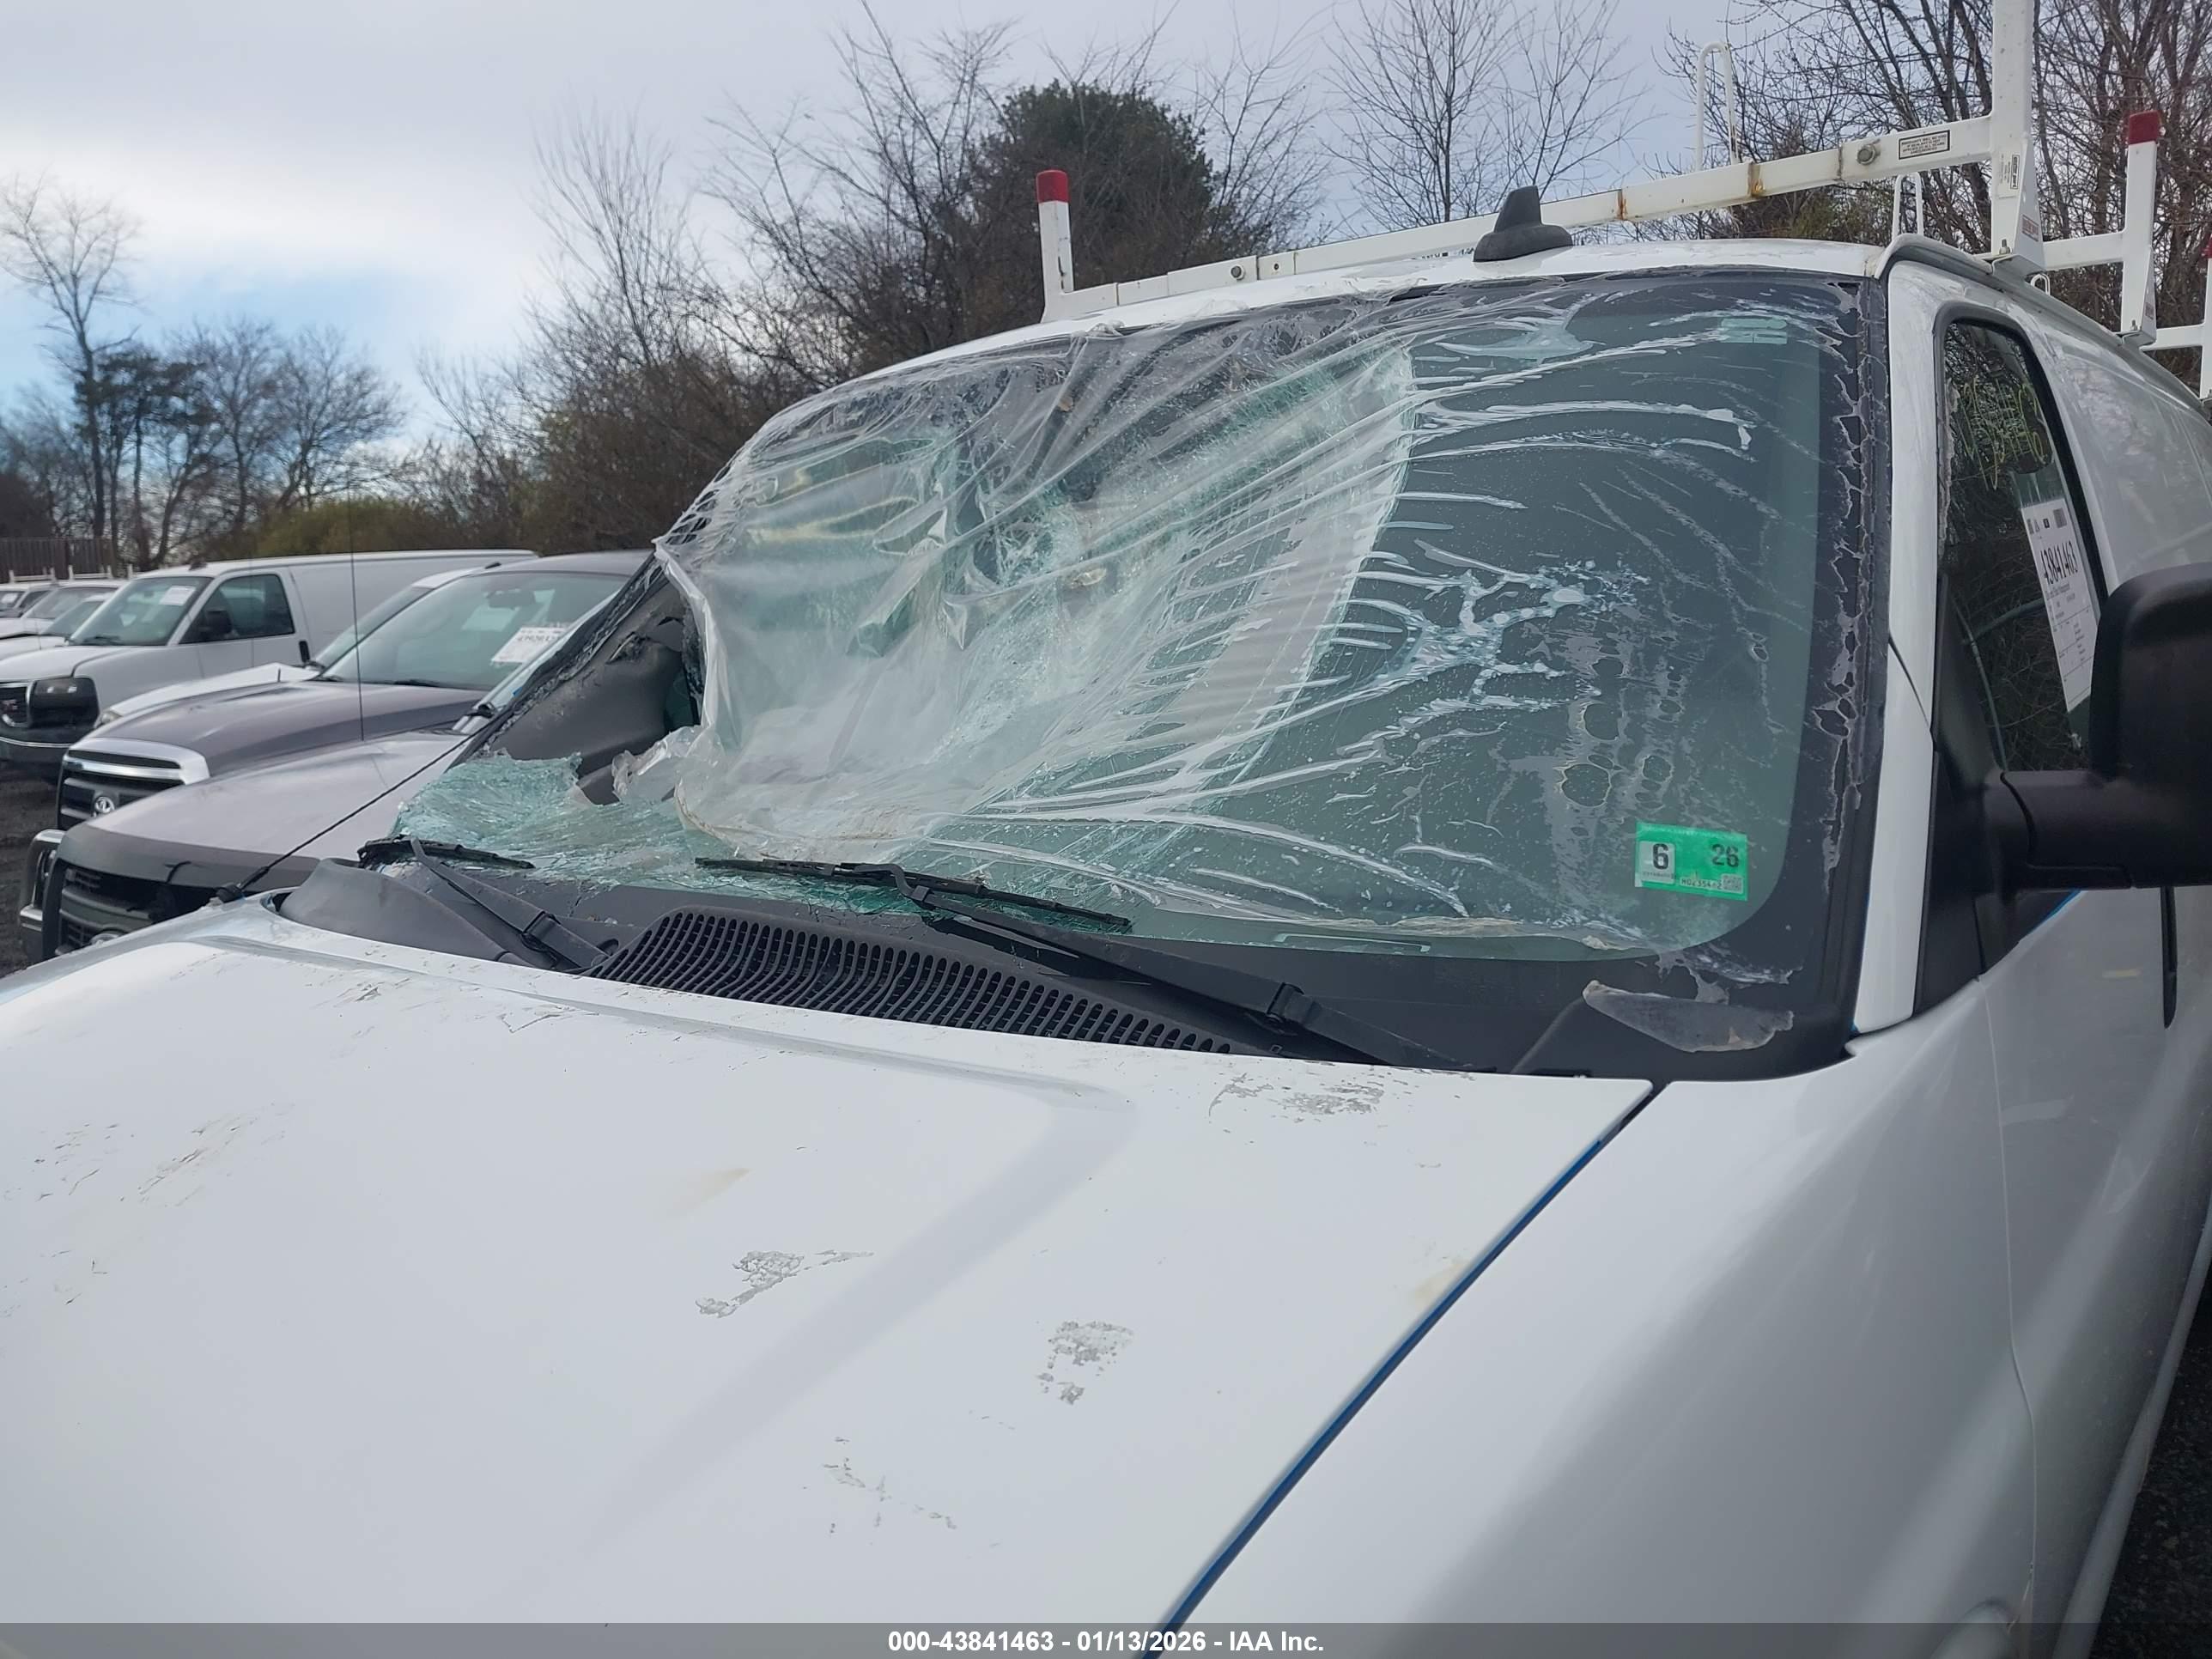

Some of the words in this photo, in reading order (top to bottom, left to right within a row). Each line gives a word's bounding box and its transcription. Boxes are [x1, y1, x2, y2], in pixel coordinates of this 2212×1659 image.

[2039, 540, 2079, 585] 43841463
[1652, 843, 1669, 870] 6
[1711, 843, 1740, 867] 26
